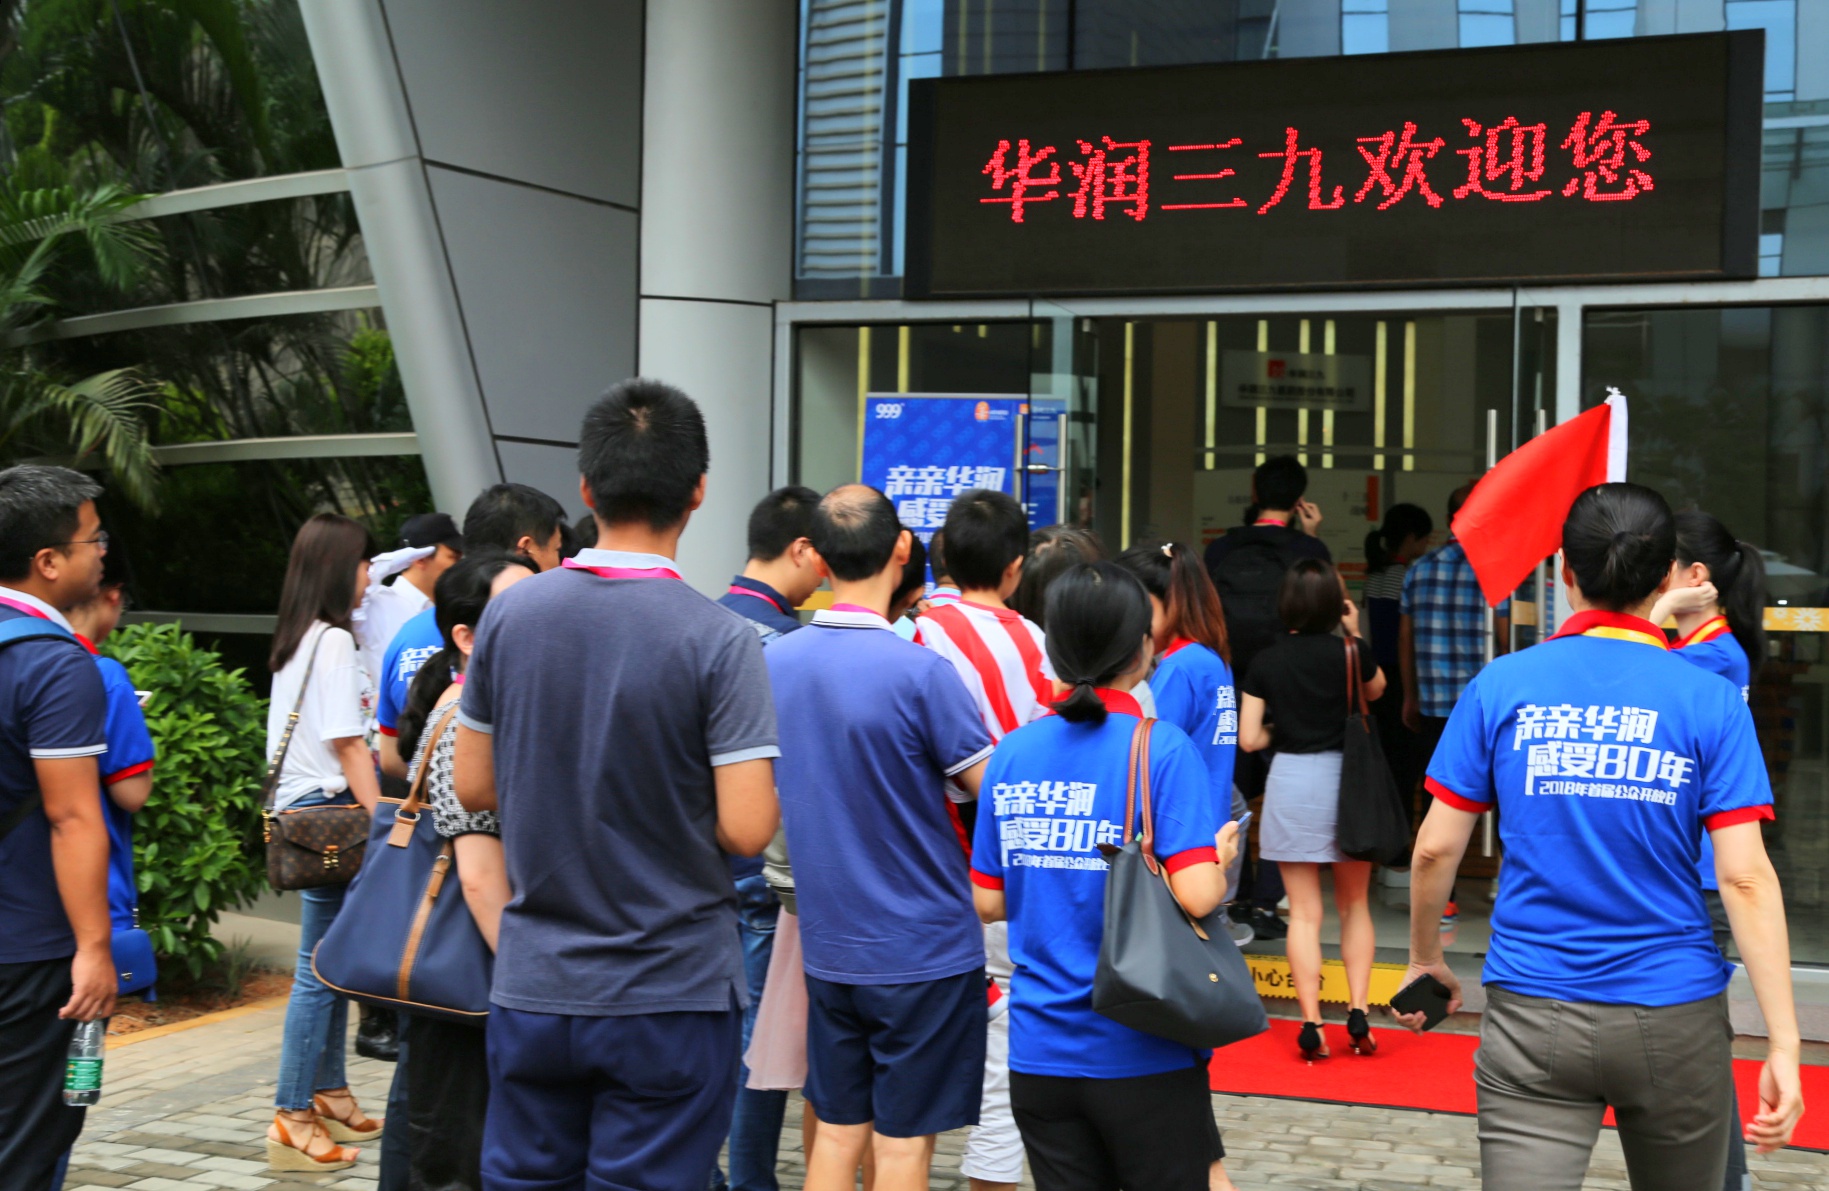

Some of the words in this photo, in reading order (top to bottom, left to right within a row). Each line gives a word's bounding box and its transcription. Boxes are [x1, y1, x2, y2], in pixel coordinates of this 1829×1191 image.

[980, 110, 1655, 223] 华润三九欢迎您
[875, 403, 902, 419] 999
[1513, 703, 1659, 751] 亲亲华润
[1524, 740, 1696, 796] 感受80年
[992, 780, 1098, 817] 亲亲华润
[1538, 780, 1678, 806] 2018年首届公众开放日
[999, 816, 1124, 868] 感受80年
